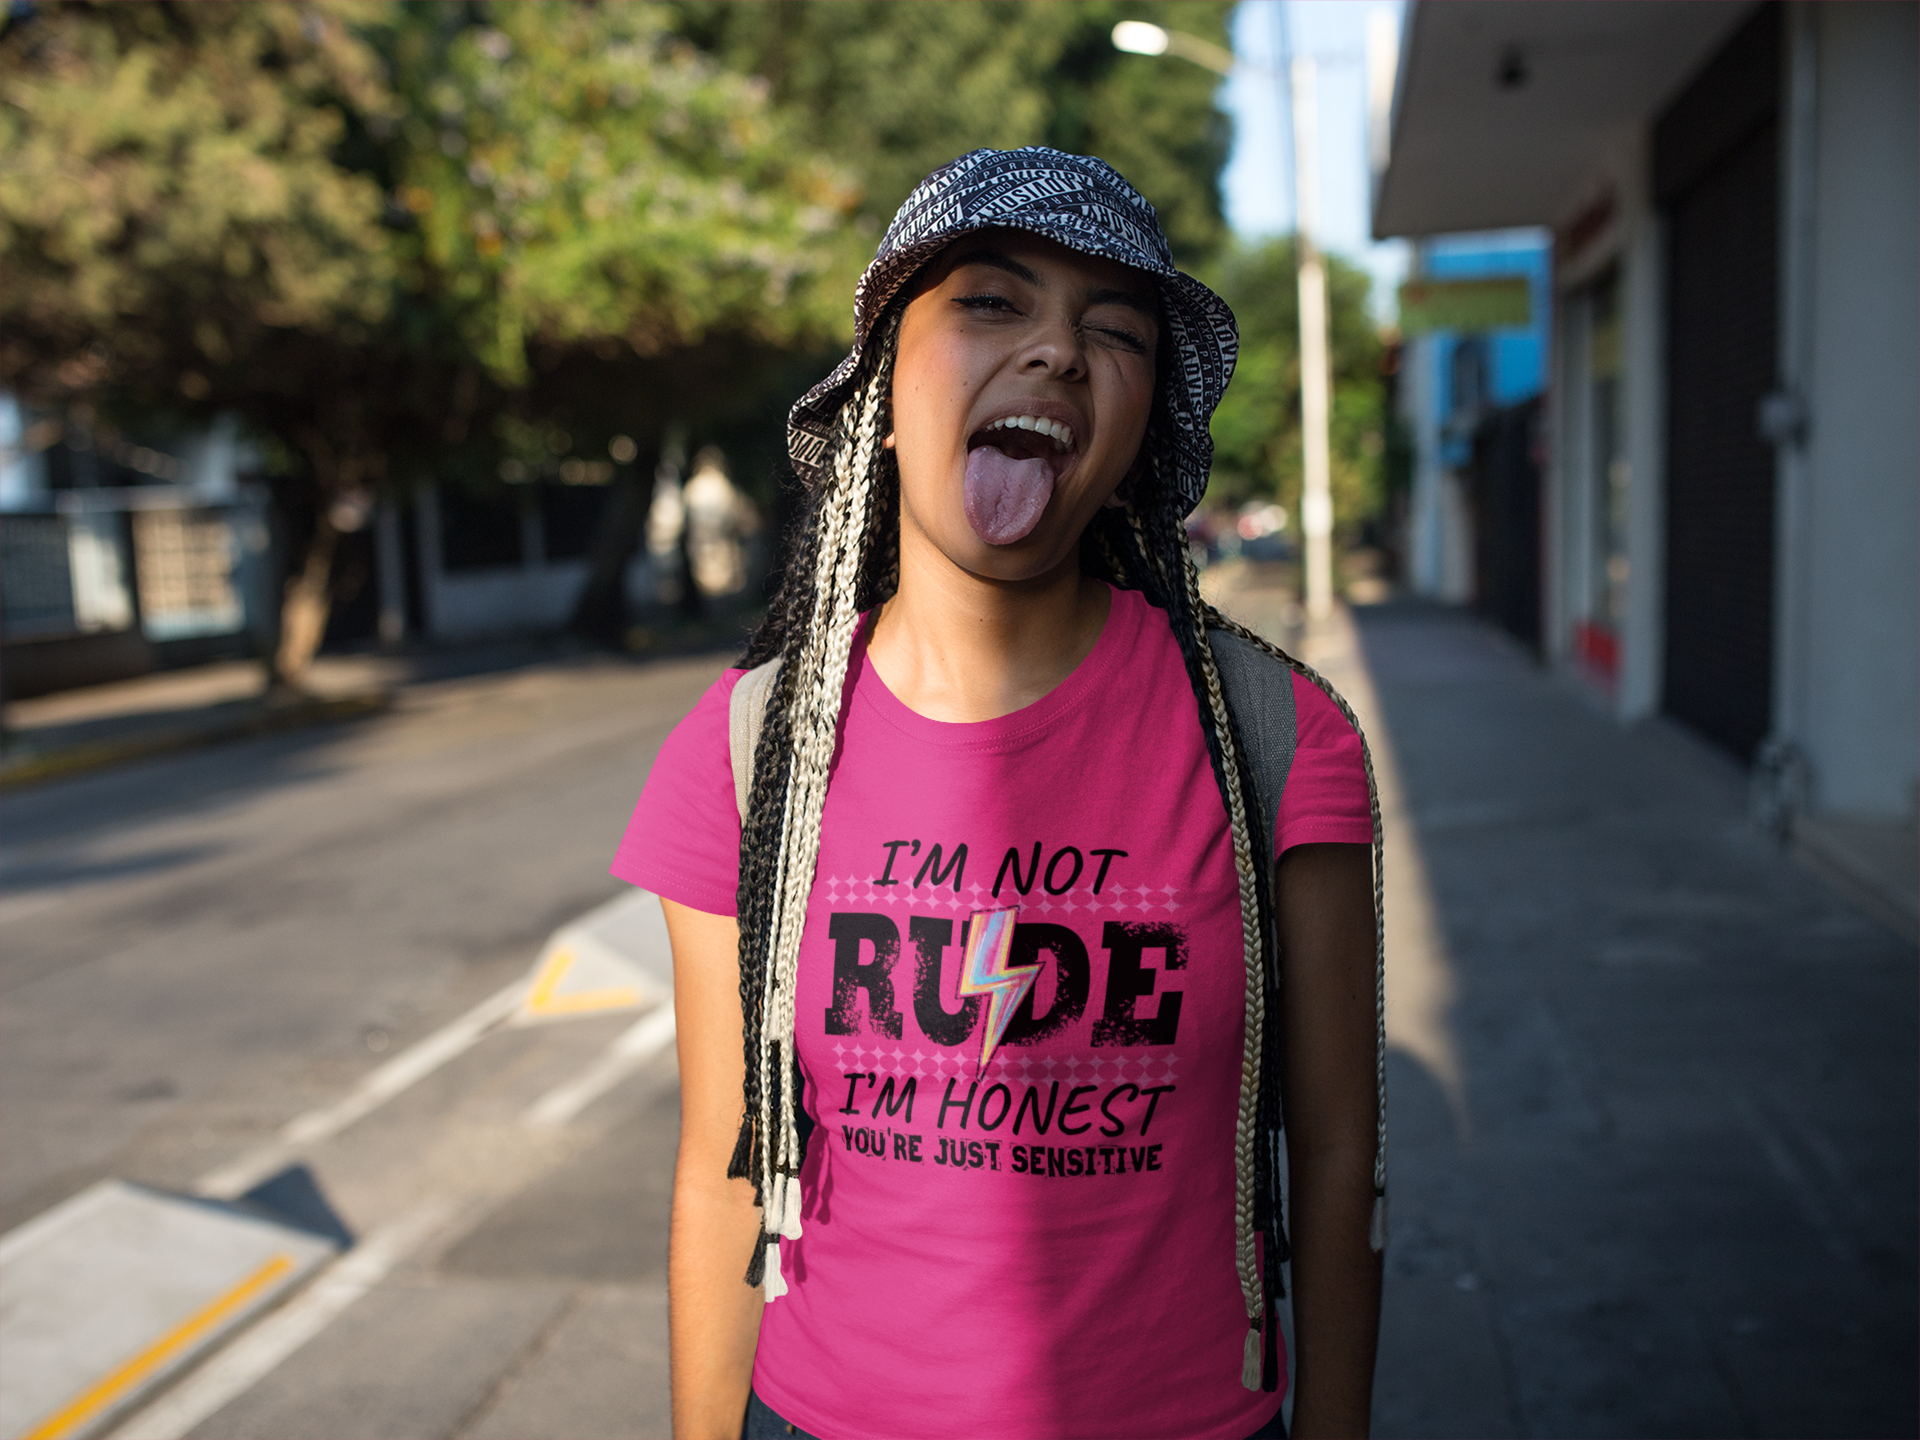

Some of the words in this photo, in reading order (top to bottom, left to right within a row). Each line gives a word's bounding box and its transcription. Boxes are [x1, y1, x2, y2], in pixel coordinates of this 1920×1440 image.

[976, 176, 1079, 220] ADVISORY
[983, 161, 1084, 179] PARENTAL
[1208, 313, 1236, 386] ADVIS
[873, 839, 969, 892] I'M
[992, 841, 1129, 899] NOT
[824, 912, 1190, 1048] RUDE
[839, 1073, 917, 1124] I'M
[937, 1077, 1177, 1137] HONEST
[841, 1125, 924, 1163] YOU'RE
[933, 1136, 1002, 1172] JUST
[1011, 1142, 1164, 1178] SENSITIVE
